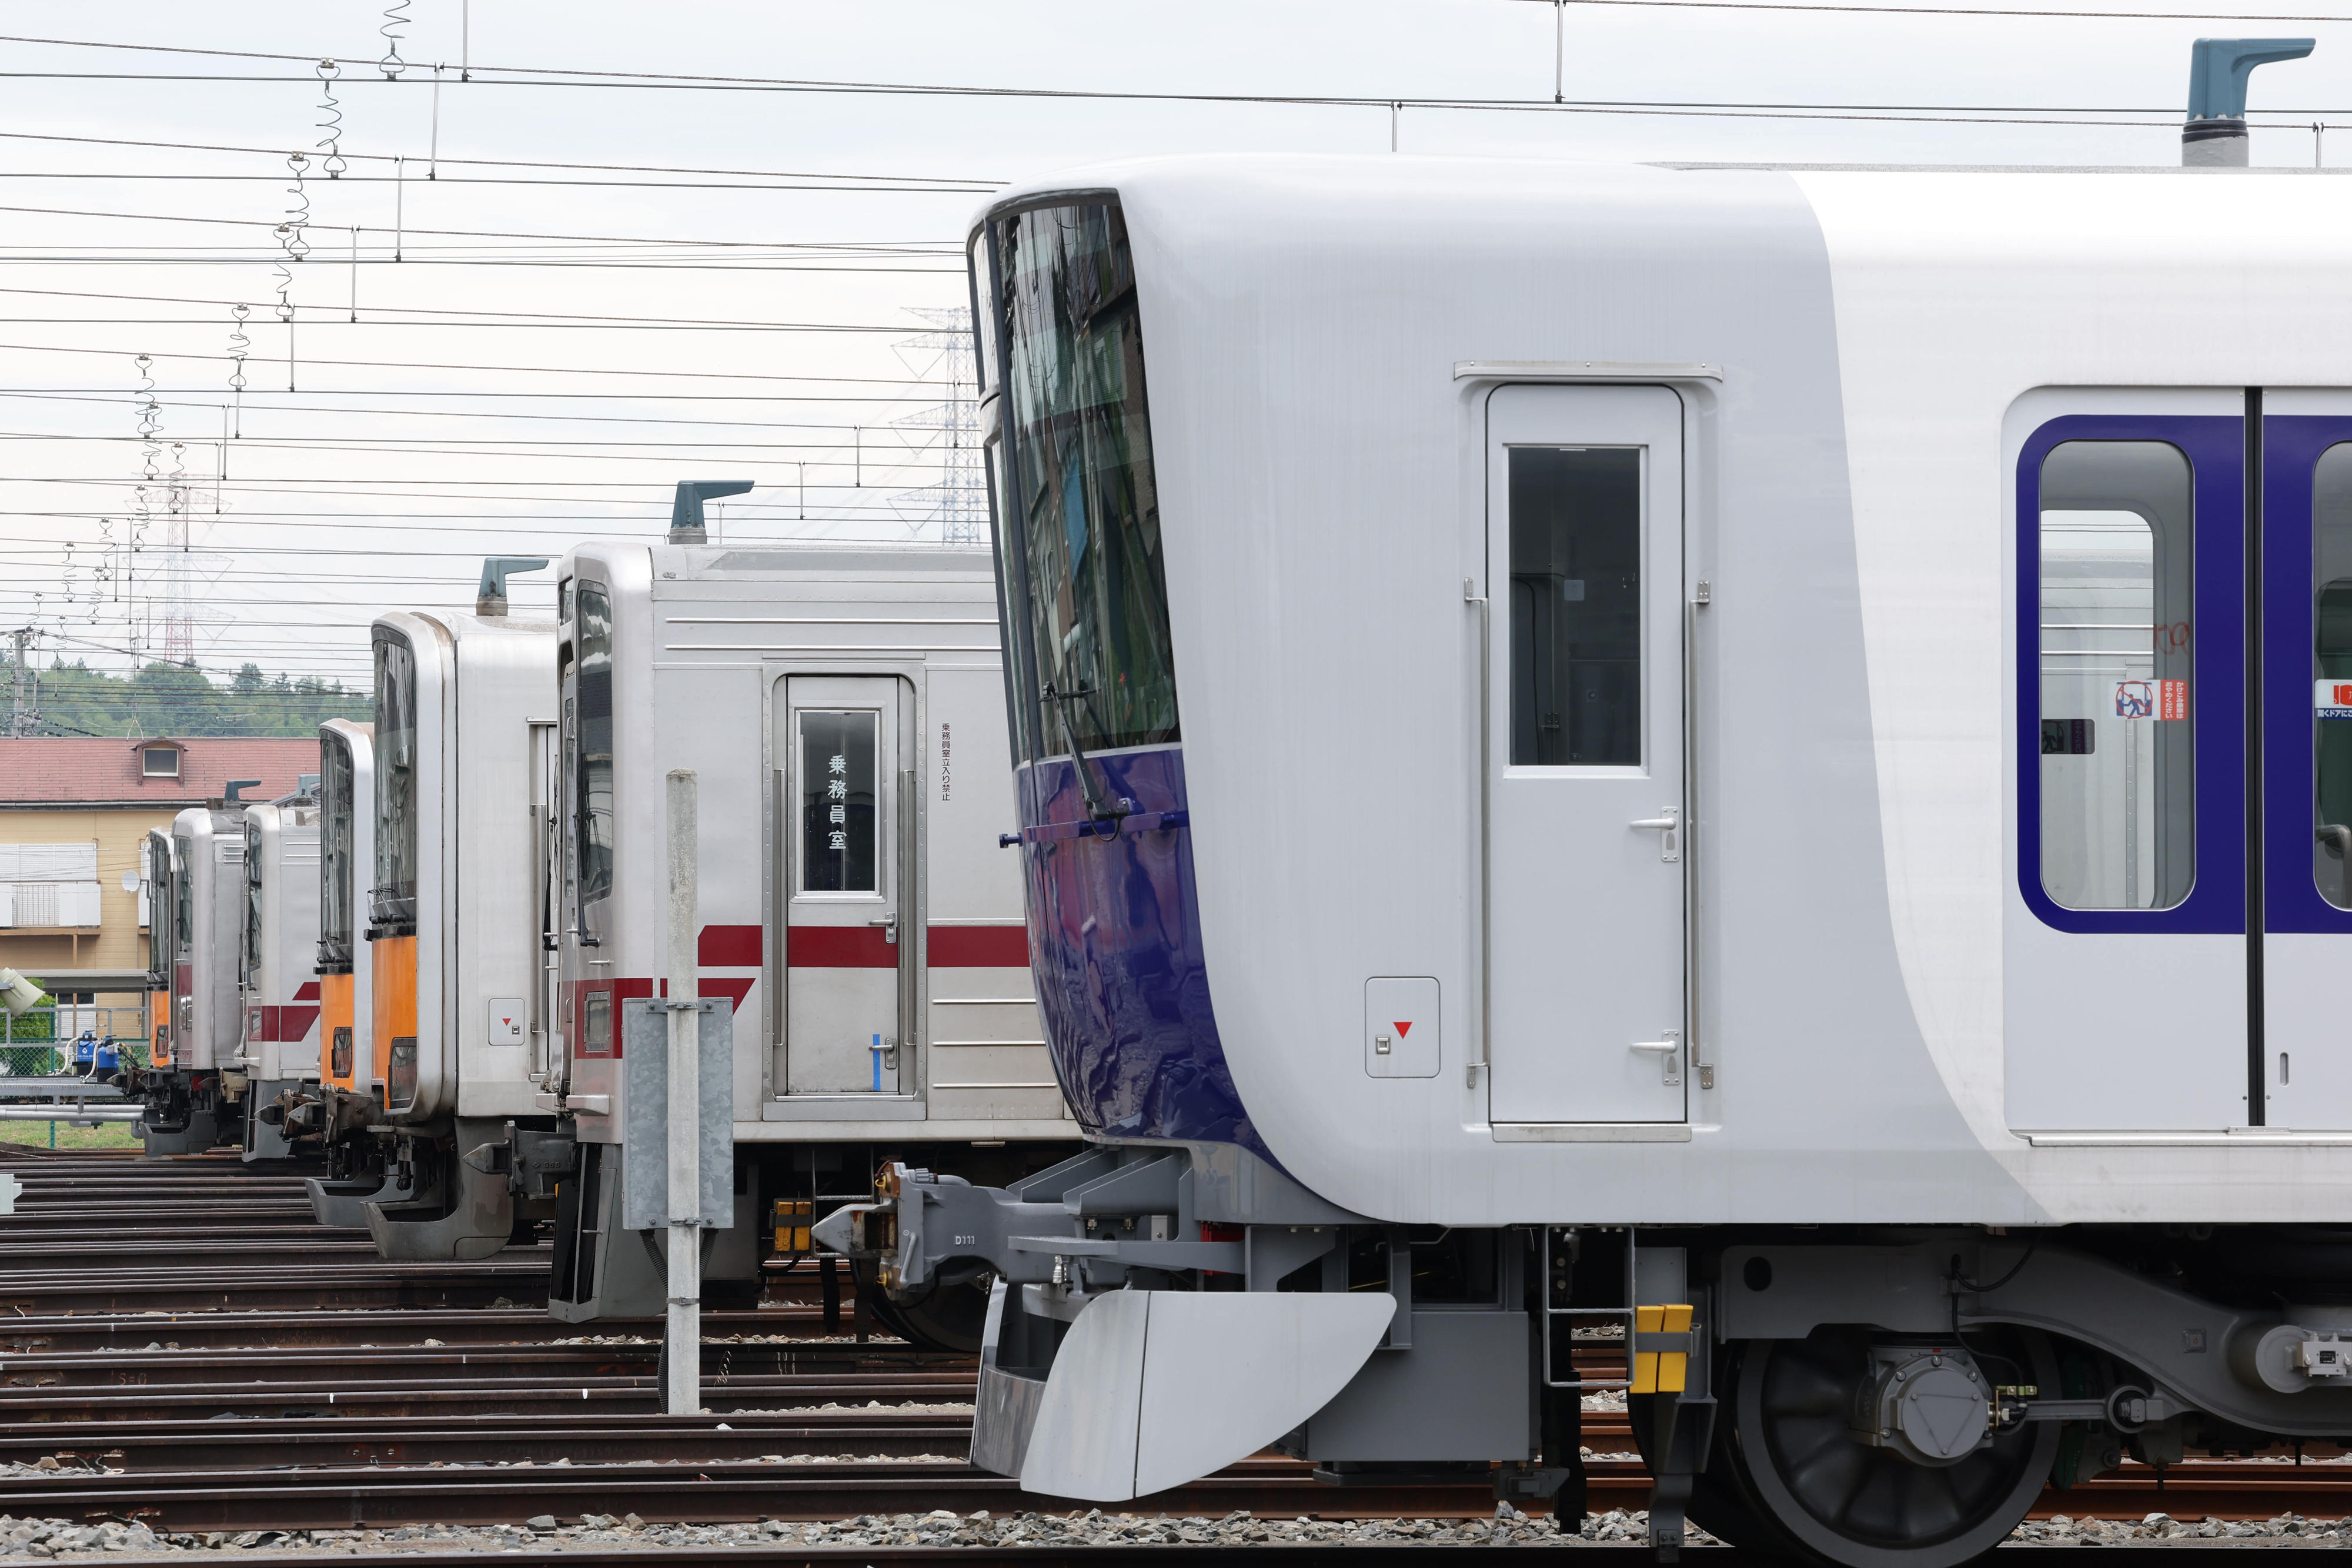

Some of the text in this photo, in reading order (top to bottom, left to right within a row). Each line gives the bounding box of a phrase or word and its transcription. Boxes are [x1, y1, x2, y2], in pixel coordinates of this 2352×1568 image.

[827, 754, 847, 850] 乗務員室
[941, 723, 950, 801] 乗務員室立入り禁止
